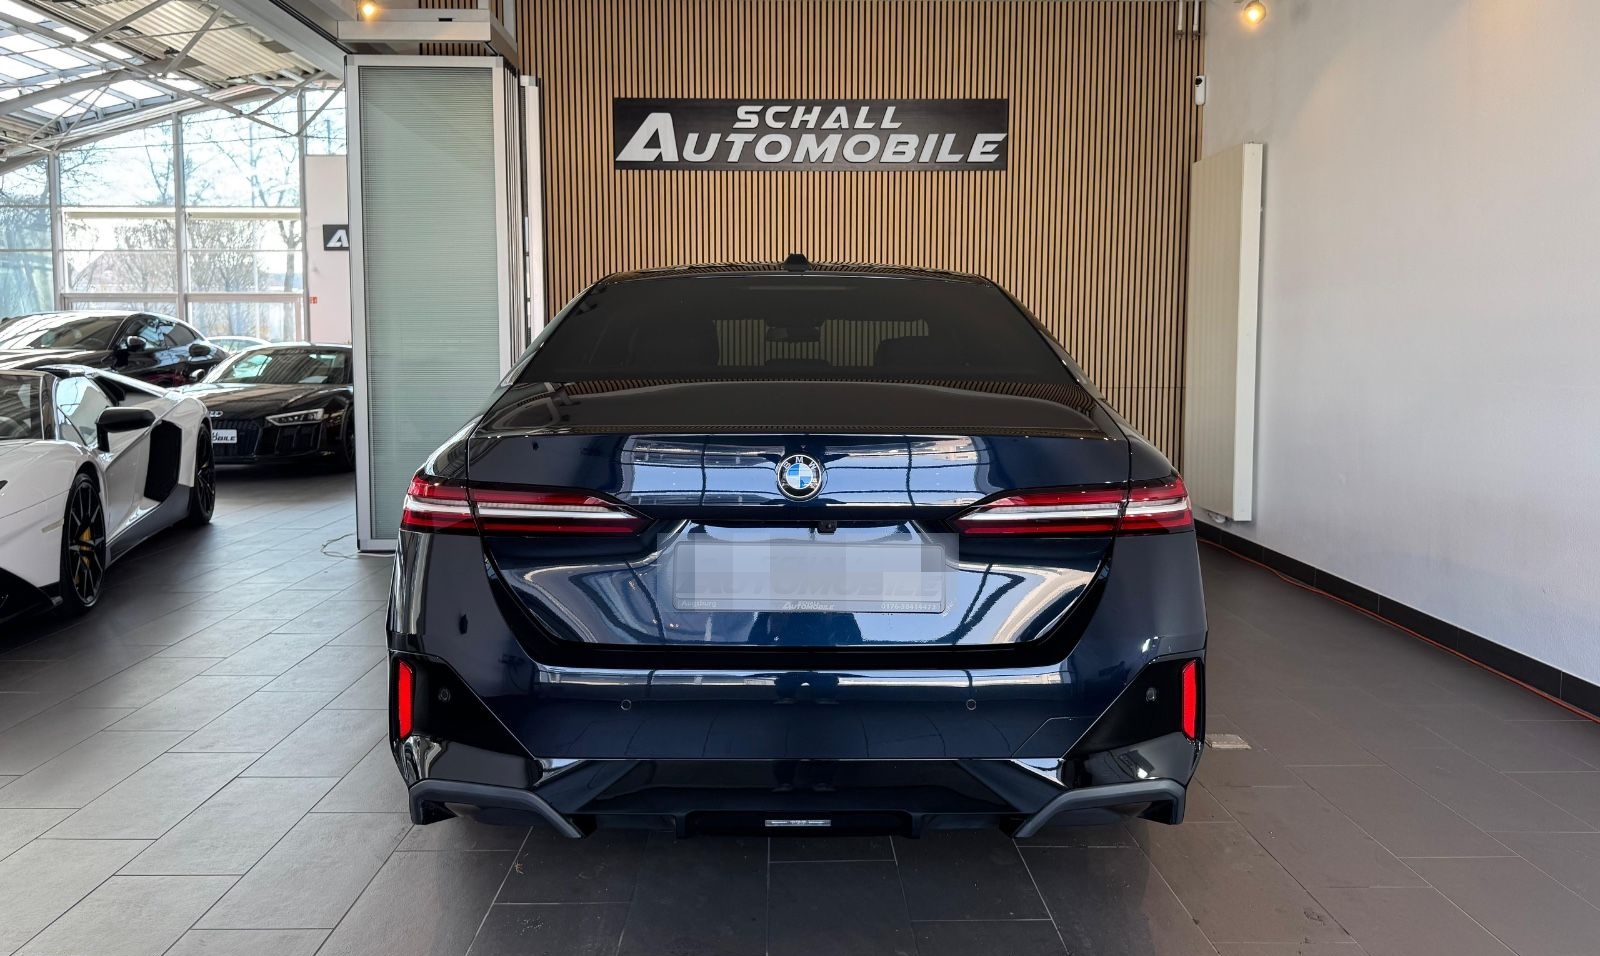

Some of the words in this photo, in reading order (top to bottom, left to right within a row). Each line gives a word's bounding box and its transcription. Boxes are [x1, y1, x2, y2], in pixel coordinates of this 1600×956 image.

[733, 105, 902, 129] SCHALL
[615, 112, 1007, 164] AUTOMOBILE
[782, 456, 817, 470] BMW
[681, 600, 717, 608] Augsburg
